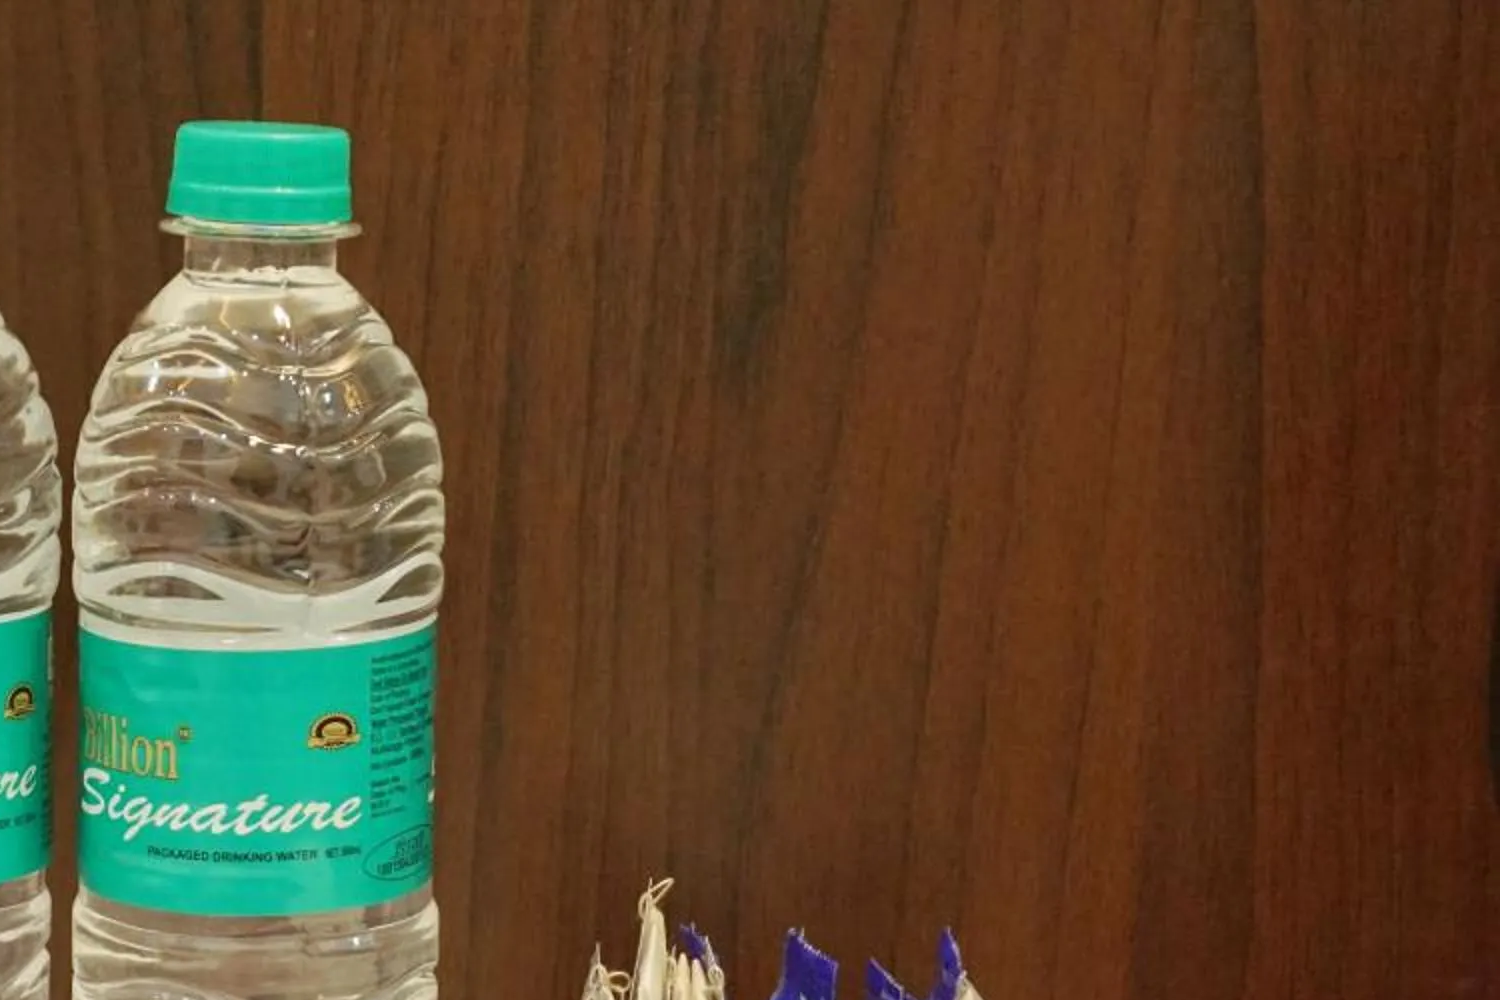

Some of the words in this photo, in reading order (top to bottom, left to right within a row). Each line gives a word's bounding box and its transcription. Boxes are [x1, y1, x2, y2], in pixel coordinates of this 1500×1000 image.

[80, 767, 363, 841] Signature
[147, 844, 209, 861] PACKAGED
[275, 848, 318, 862] WATER
